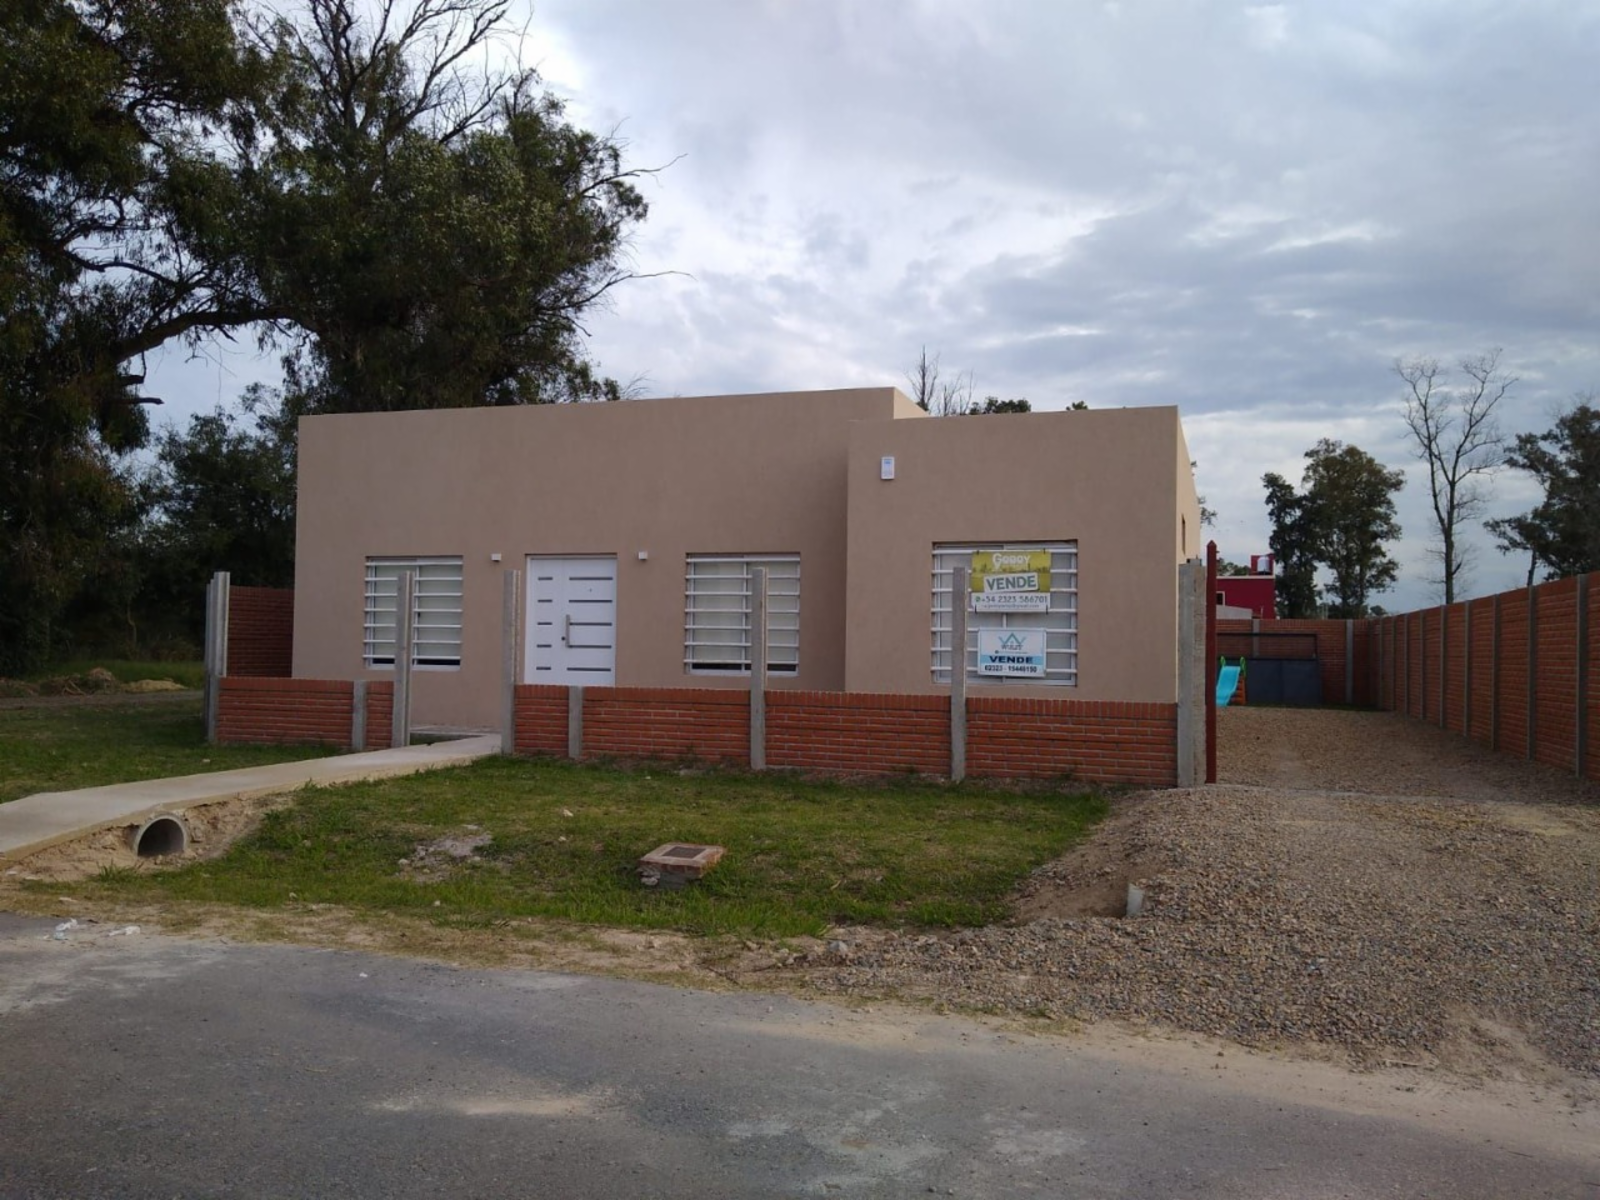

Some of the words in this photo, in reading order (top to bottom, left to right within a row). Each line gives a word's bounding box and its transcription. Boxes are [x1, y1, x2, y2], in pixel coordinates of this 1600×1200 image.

[986, 575, 1036, 590] VENDE
[998, 595, 1017, 603] 2323
[989, 655, 1034, 663] VENDE
